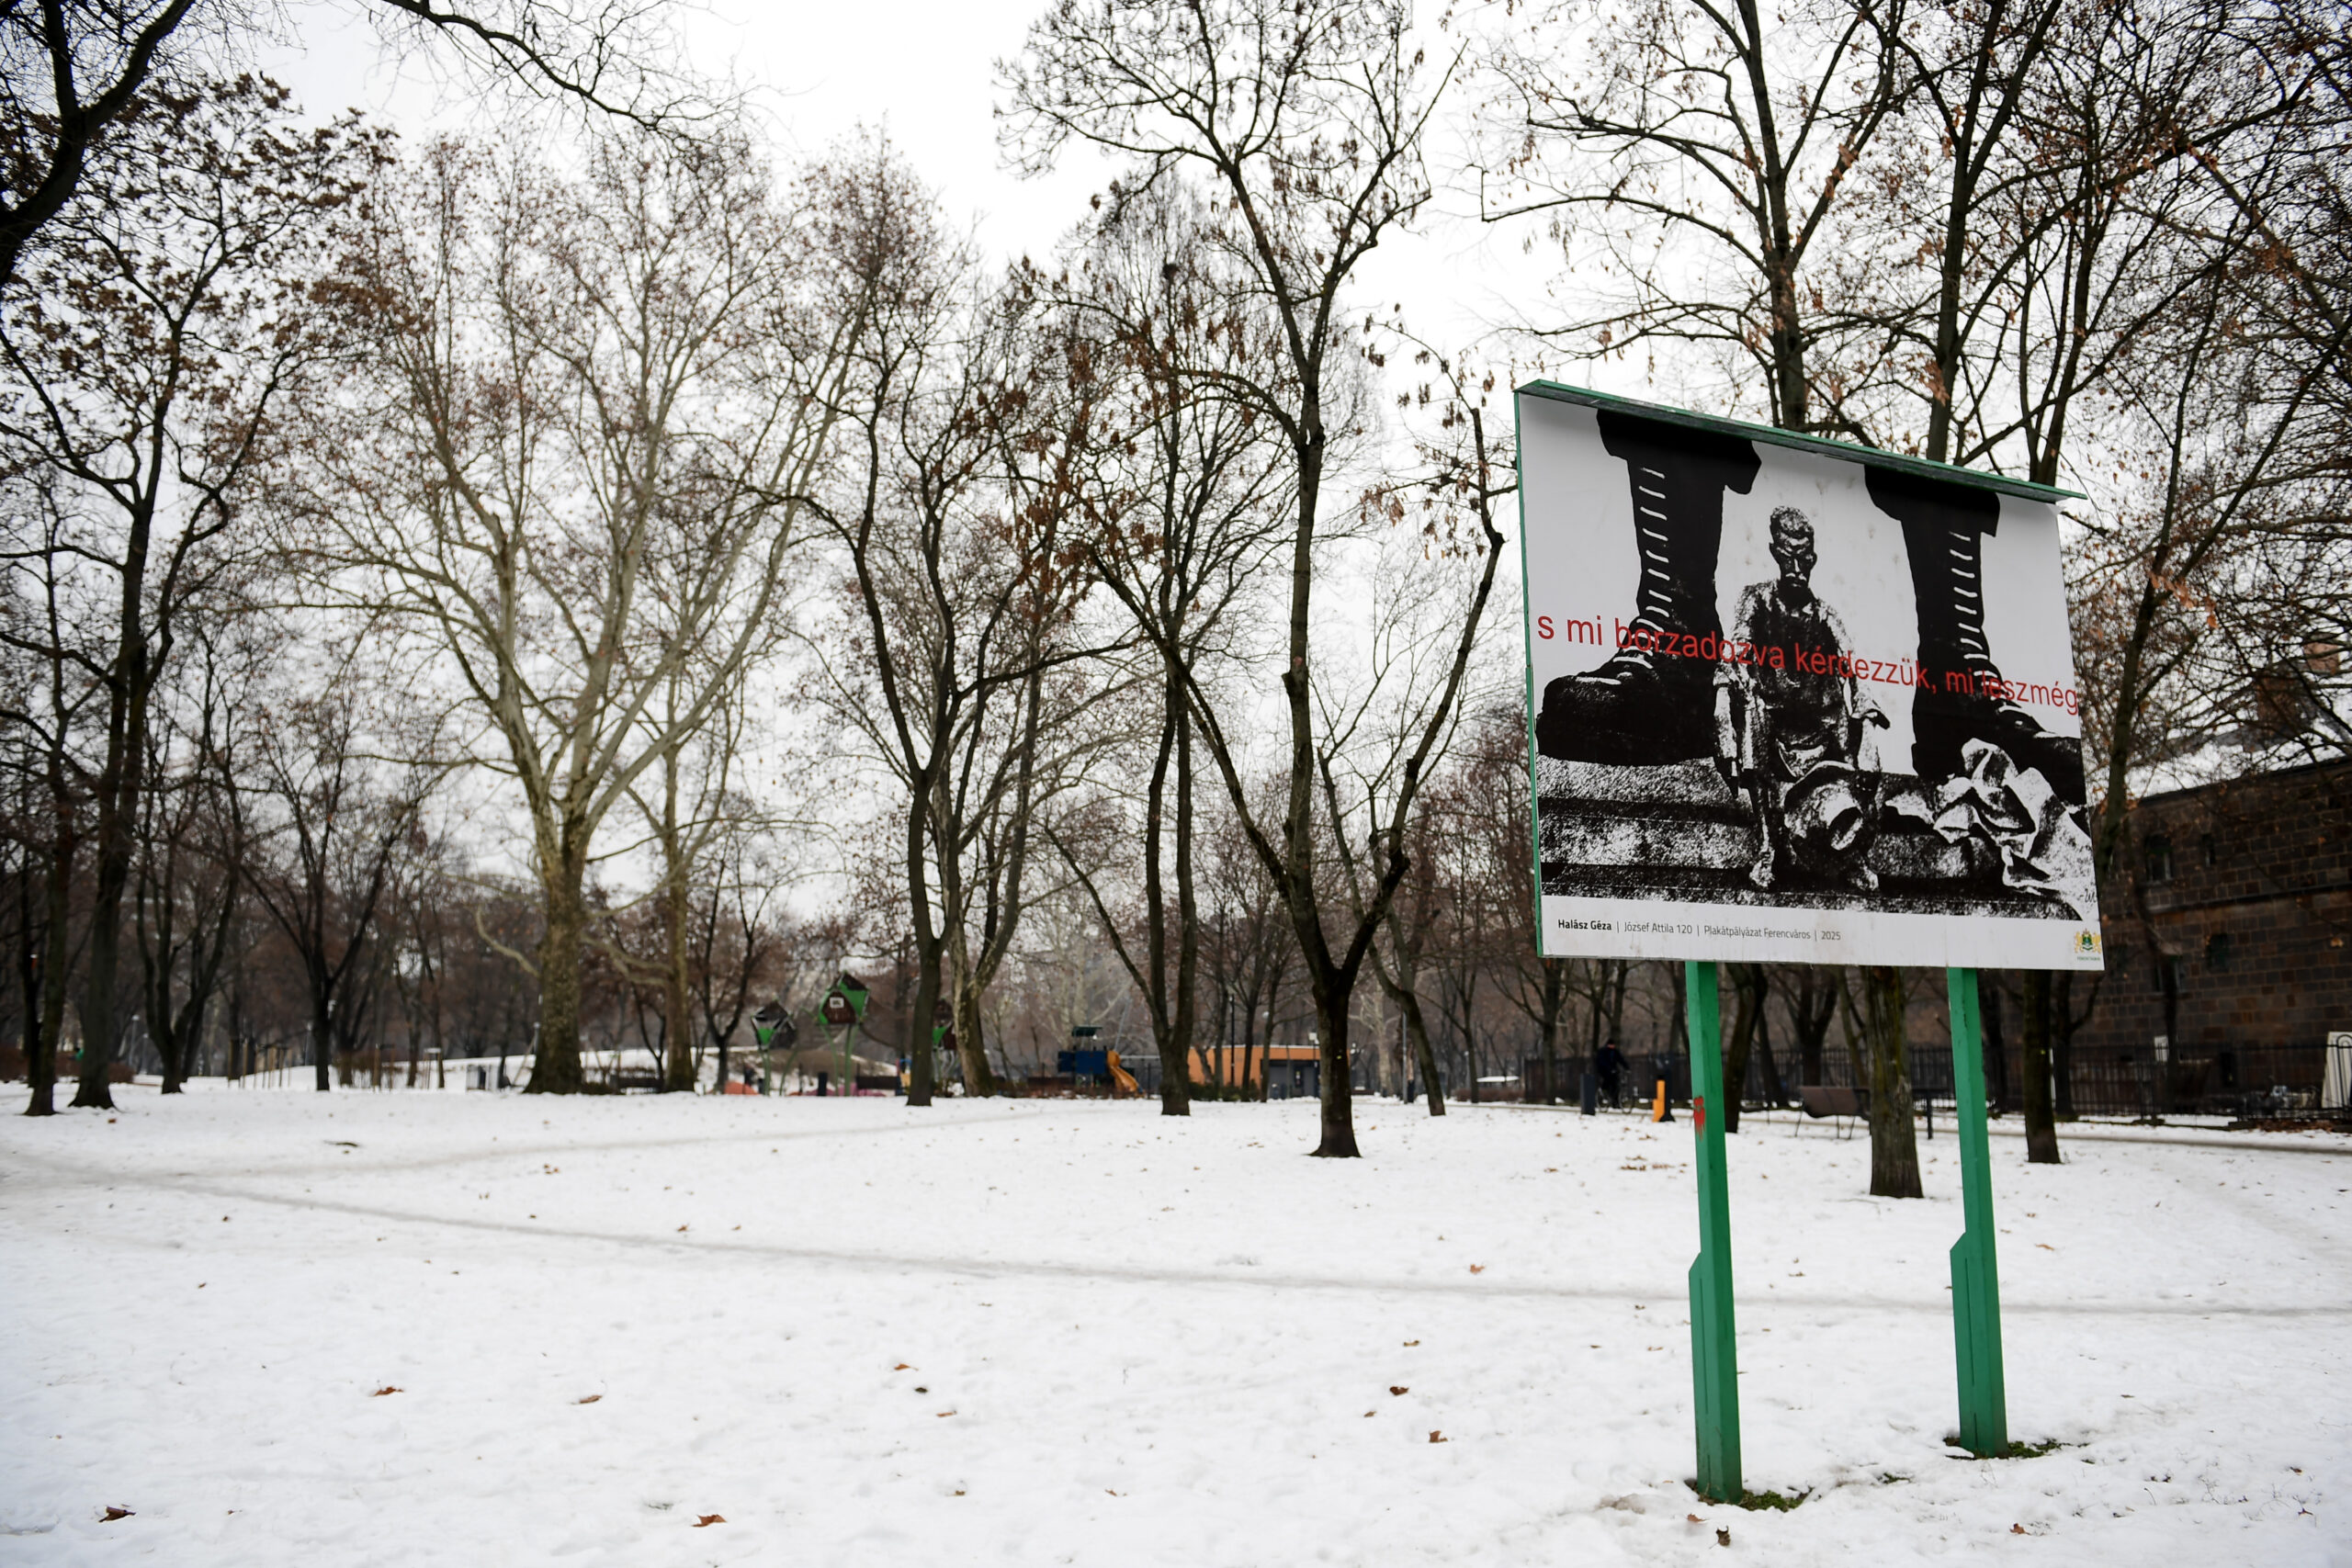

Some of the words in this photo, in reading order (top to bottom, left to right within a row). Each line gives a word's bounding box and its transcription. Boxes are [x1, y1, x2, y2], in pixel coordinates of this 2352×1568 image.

[1537, 615, 1555, 641] s
[1566, 615, 1603, 646] mi
[1614, 617, 1786, 670] borzadozva
[1794, 642, 1938, 694] kérdezzük,
[1945, 667, 1975, 695] mi
[1557, 919, 1589, 930] Halász
[1590, 919, 1612, 931] Géza
[1623, 921, 1650, 932] József
[1651, 922, 1674, 933] Attila
[1677, 924, 1692, 934] 120
[1703, 925, 1762, 939] Plakátpályázat
[1764, 927, 1811, 940] Ferencváros
[1821, 931, 1841, 941] 2025
